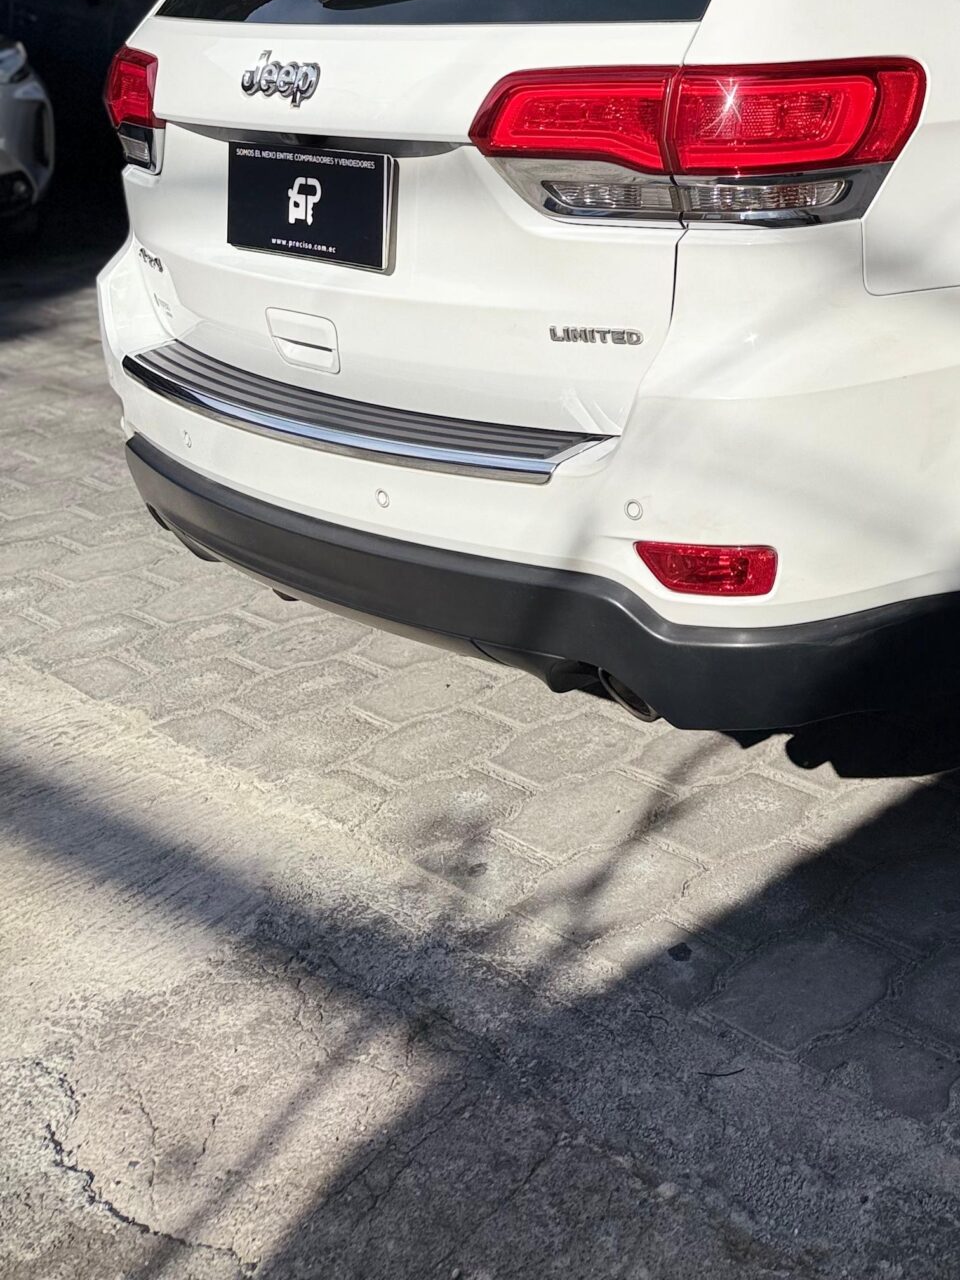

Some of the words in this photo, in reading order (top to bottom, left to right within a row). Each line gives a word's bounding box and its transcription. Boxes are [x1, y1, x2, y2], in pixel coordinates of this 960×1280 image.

[241, 50, 321, 108] Jeep
[236, 148, 254, 157] SOMOS
[255, 149, 262, 158] EL
[262, 150, 276, 159] NEXO
[277, 151, 293, 160] ENTRE
[294, 153, 334, 165] COMPRADORES
[338, 158, 375, 169] VENDEDORES
[271, 237, 336, 254] www.preciso.com.ec
[549, 325, 644, 345] LIMITED
